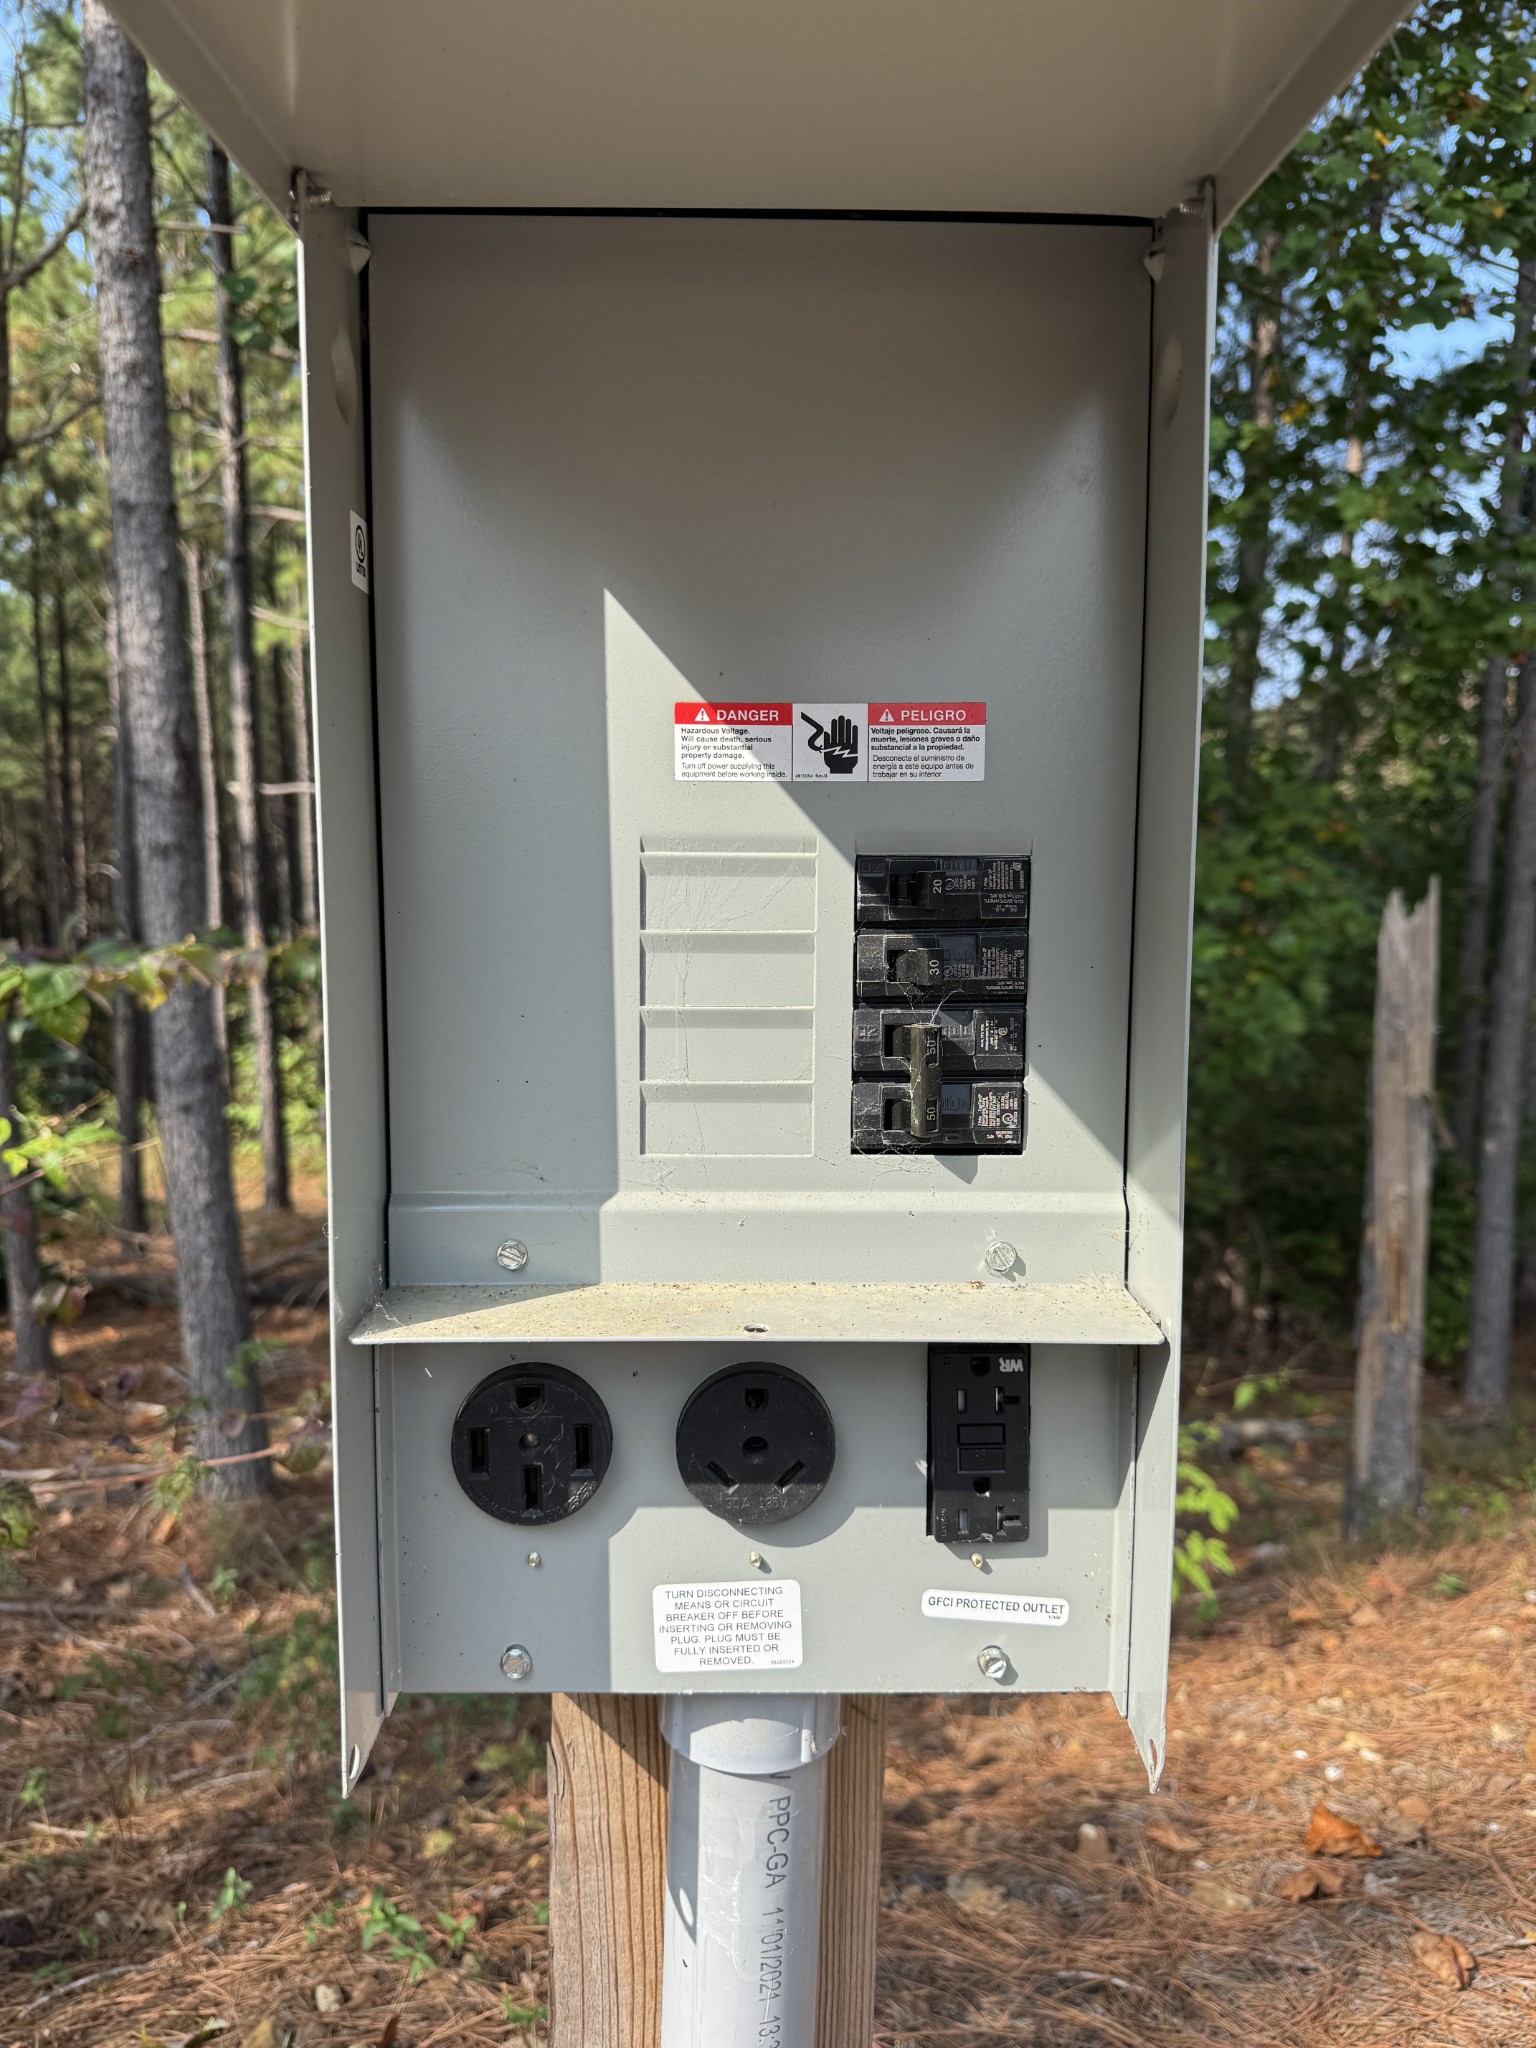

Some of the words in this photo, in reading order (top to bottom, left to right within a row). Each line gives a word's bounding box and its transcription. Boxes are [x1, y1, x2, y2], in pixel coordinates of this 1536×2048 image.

[716, 710, 779, 721] DANGER
[901, 710, 966, 721] PELIGRO
[721, 727, 750, 735] Voltage.
[870, 727, 895, 735] Voltaje
[897, 727, 931, 735] peligroso.
[933, 726, 963, 734] Causará
[681, 752, 711, 760] property
[921, 763, 944, 771] equipo
[933, 879, 942, 894] 20
[929, 960, 940, 975] 30
[927, 1040, 936, 1055] 50
[927, 1107, 936, 1120] 50
[1000, 1356, 1024, 1373] WR
[726, 1496, 750, 1509] 30A
[760, 1496, 788, 1509] 125V
[665, 1590, 694, 1599] TURN
[696, 1587, 783, 1598] DISCONNECTING
[674, 1601, 712, 1610] MEANS
[714, 1600, 730, 1609] OR
[732, 1598, 774, 1608] CIRCUIT
[928, 1596, 954, 1607] GFCI
[956, 1598, 1020, 1612] PROTECTED
[1023, 1602, 1065, 1615] OUTLET
[666, 1612, 715, 1622] BREAKER
[718, 1611, 738, 1620] OFF
[742, 1610, 784, 1619] BEFORE
[659, 1624, 715, 1634] INSERTING
[718, 1623, 733, 1631] OR
[736, 1621, 792, 1630] REMOVING
[670, 1636, 702, 1645] PLUG.
[704, 1634, 733, 1643] PLUG
[735, 1633, 764, 1642] MUST
[767, 1632, 781, 1641] BE
[674, 1647, 706, 1655] FULLY
[709, 1644, 761, 1654] INSERTED
[764, 1644, 779, 1652] OR
[700, 1656, 754, 1666] REMOVED.
[765, 1795, 791, 1888] PPC-GA
[759, 1907, 784, 2002] 101/2021
